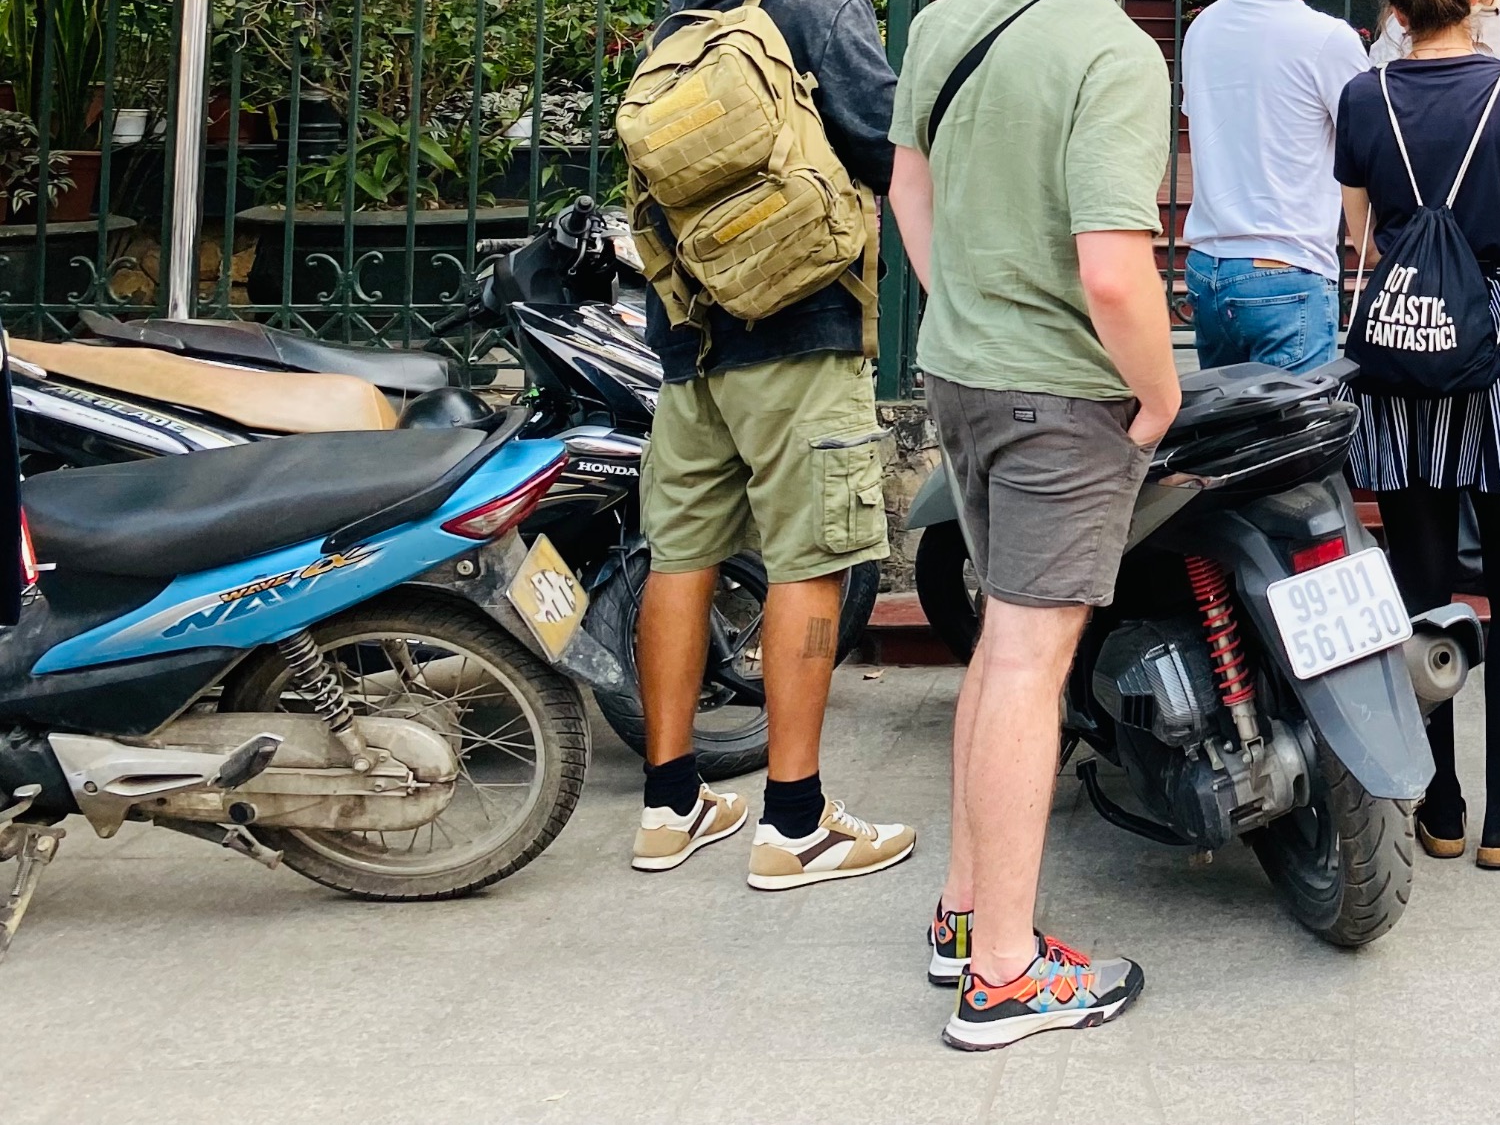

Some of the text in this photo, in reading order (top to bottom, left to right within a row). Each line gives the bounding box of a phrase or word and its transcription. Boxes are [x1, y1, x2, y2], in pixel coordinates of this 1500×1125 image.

[1368, 290, 1453, 326] PLASTIC.
[1365, 319, 1458, 352] FANTASTIC!
[577, 461, 639, 477] HONDA
[219, 571, 295, 603] WAVE
[1288, 561, 1376, 623] 99-D1
[1292, 600, 1401, 669] 561.30
